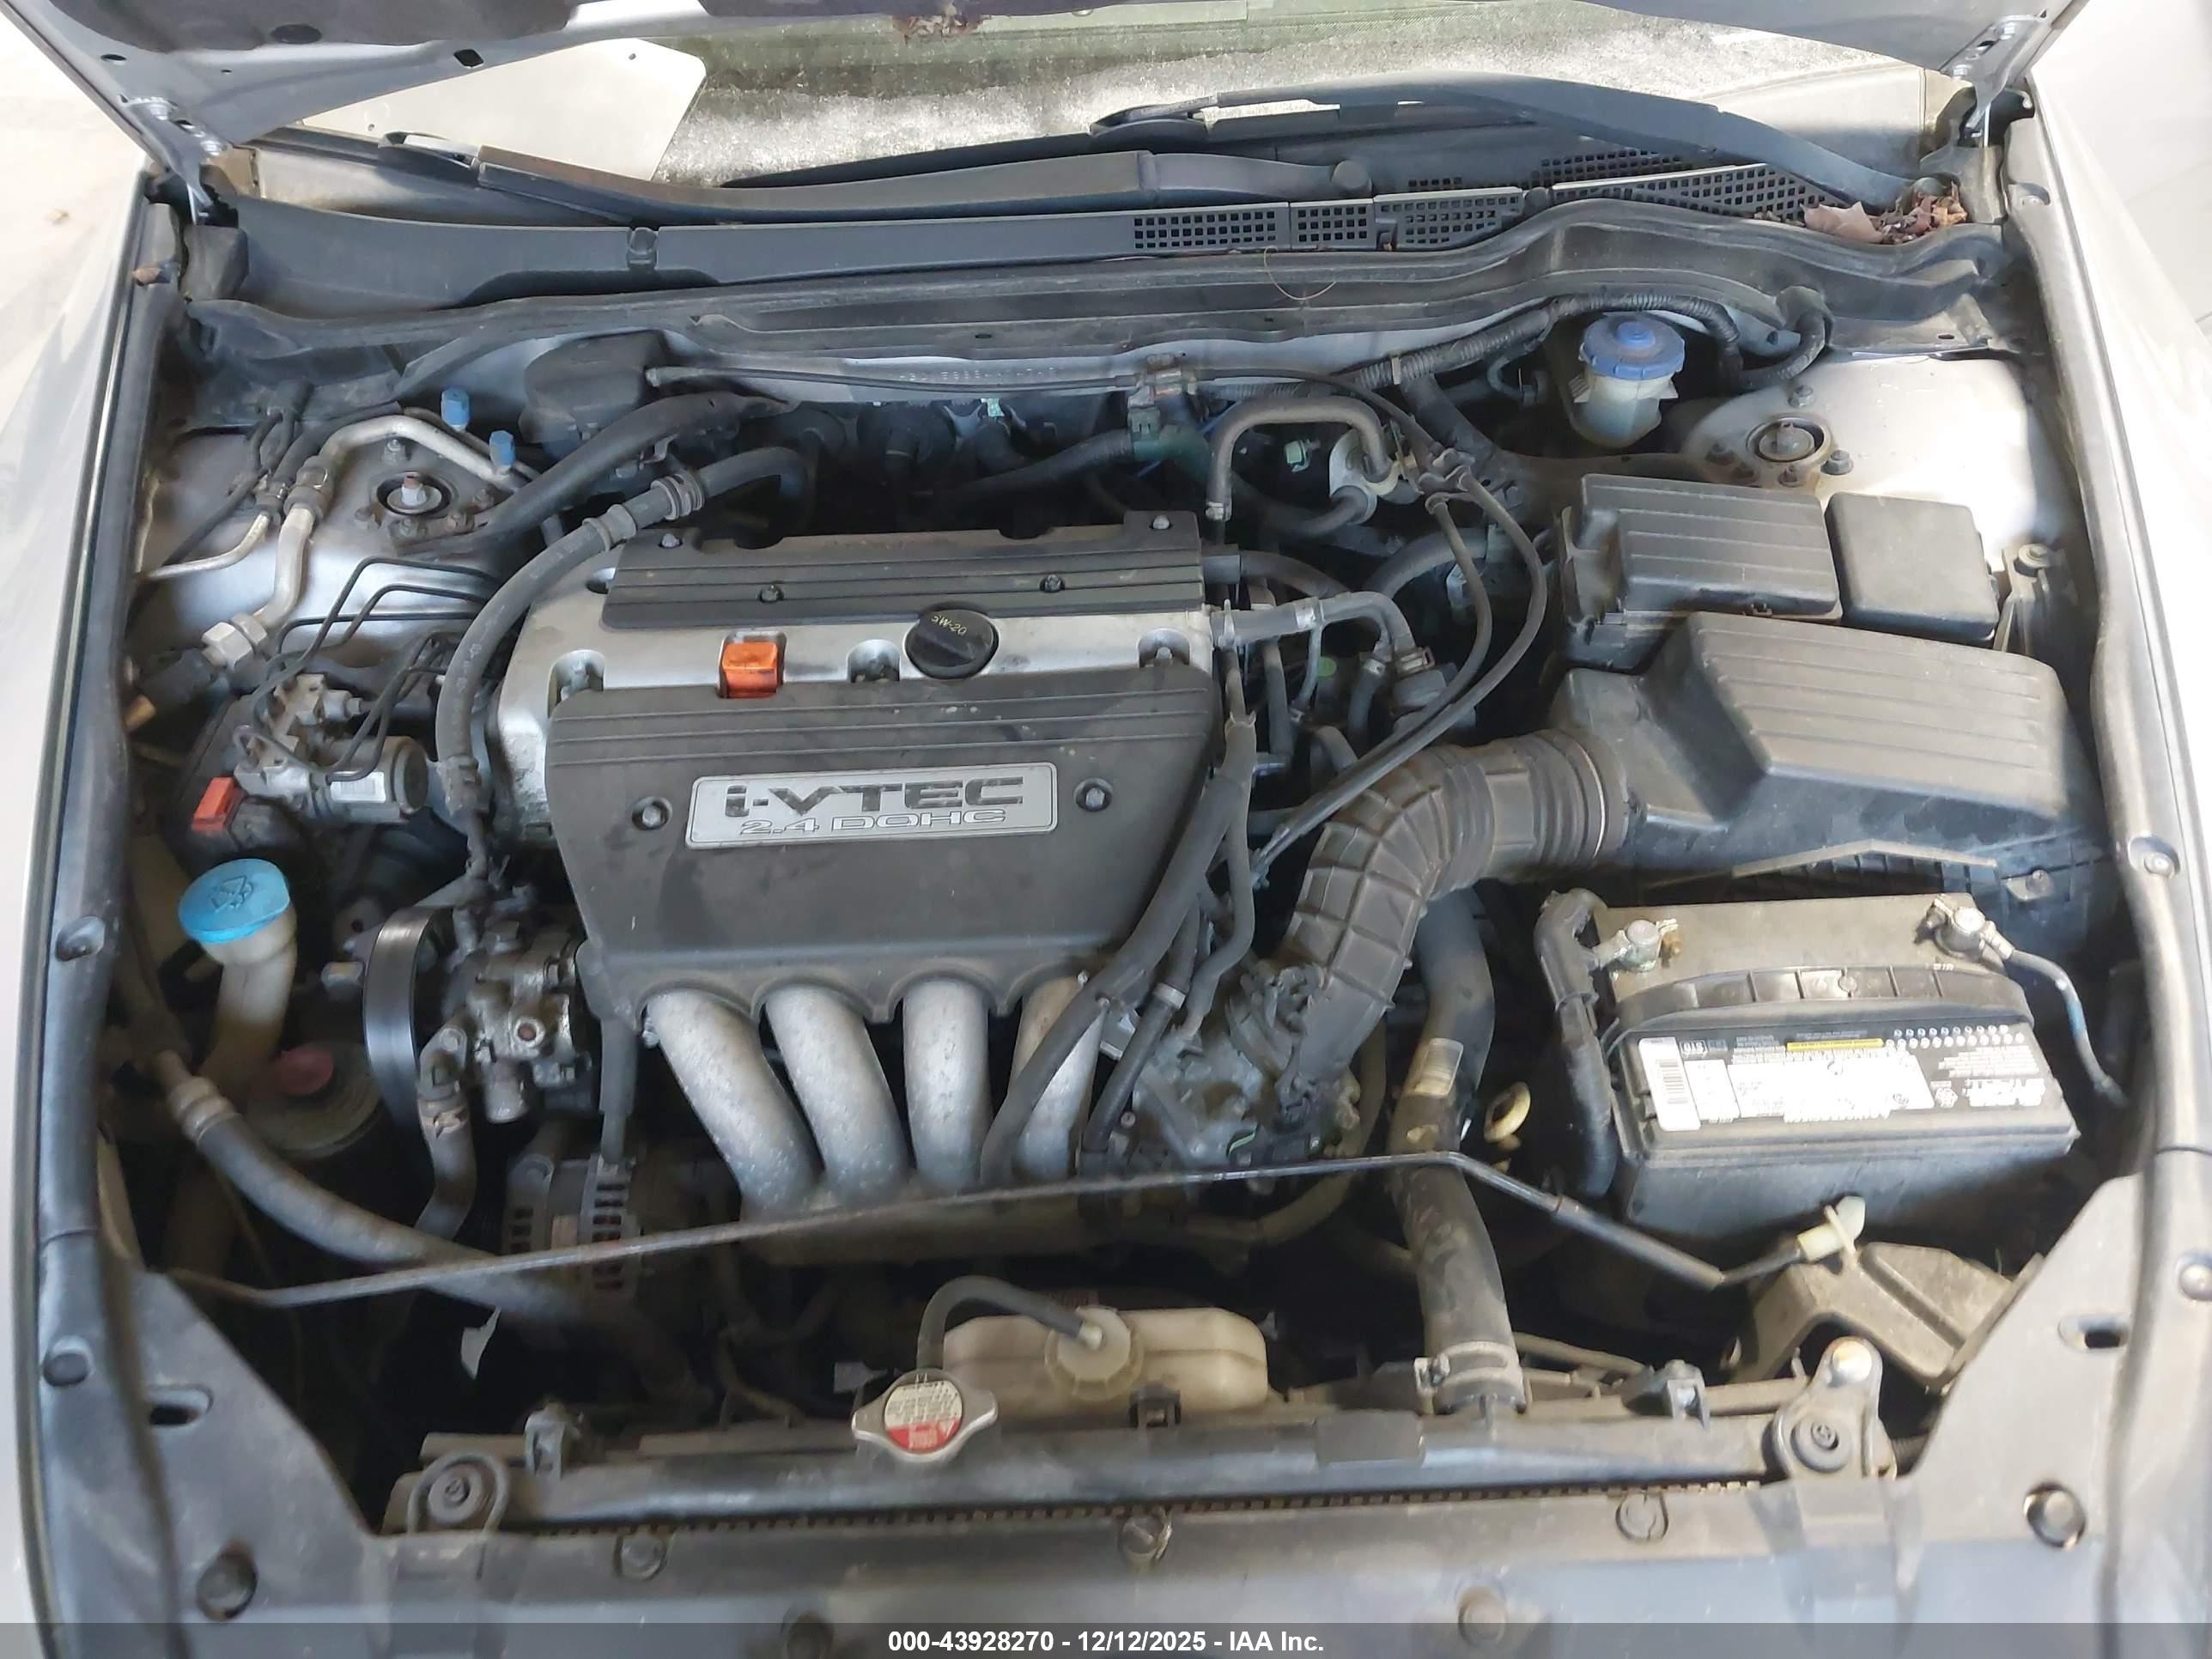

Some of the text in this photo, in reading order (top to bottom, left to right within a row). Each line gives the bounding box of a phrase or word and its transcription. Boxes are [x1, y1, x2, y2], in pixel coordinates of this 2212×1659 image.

[725, 777, 1024, 817] i-VTEC
[740, 810, 1006, 836] 2.4 DOHC
